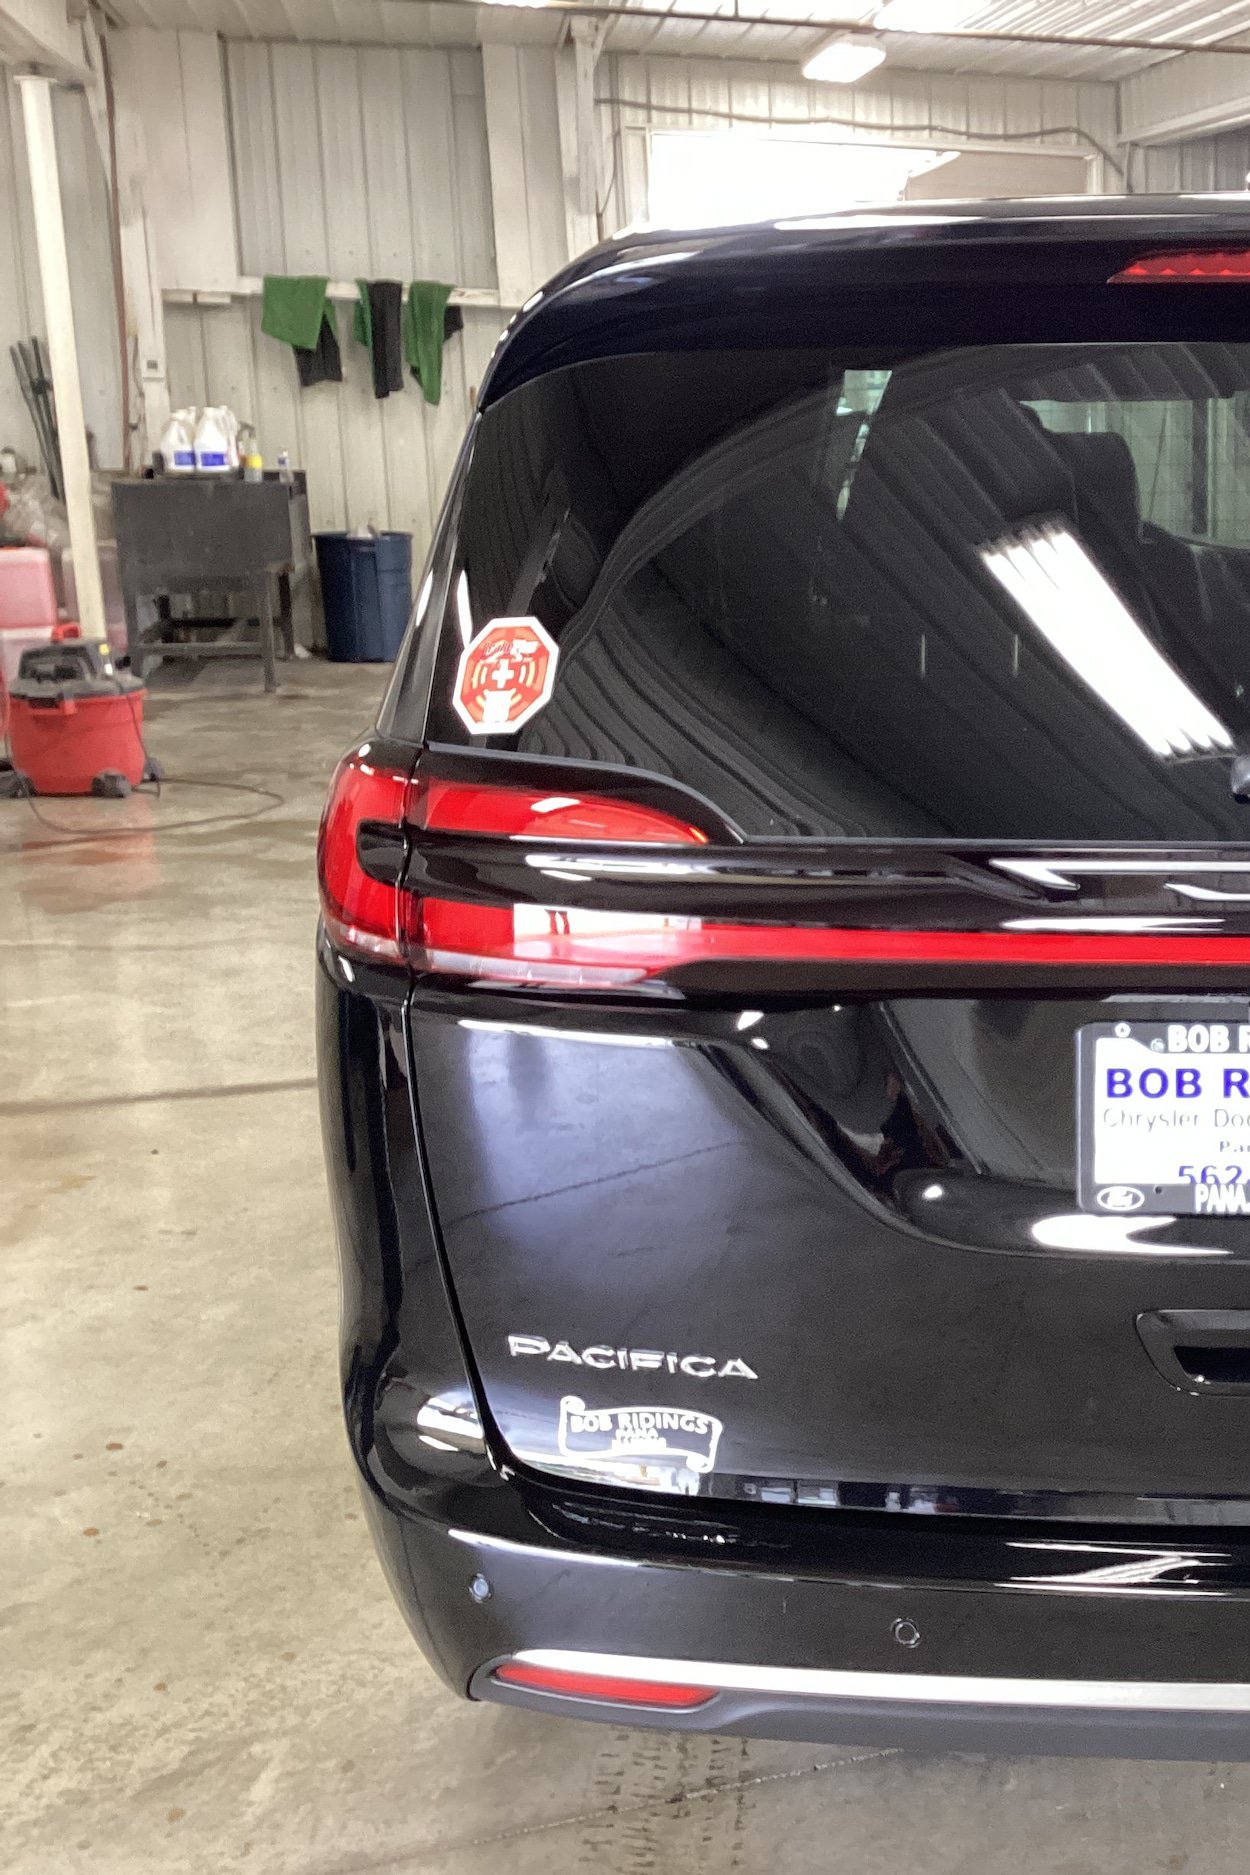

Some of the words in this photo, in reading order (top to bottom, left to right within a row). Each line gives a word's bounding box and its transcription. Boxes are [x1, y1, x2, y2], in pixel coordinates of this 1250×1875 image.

[1167, 1024, 1230, 1053] BOB
[1105, 1067, 1203, 1099] BOB
[1103, 1108, 1199, 1131] Chrysler
[507, 1333, 759, 1379] PACIFICA
[570, 1413, 613, 1433] BOB
[617, 1412, 709, 1435] RIDINGS
